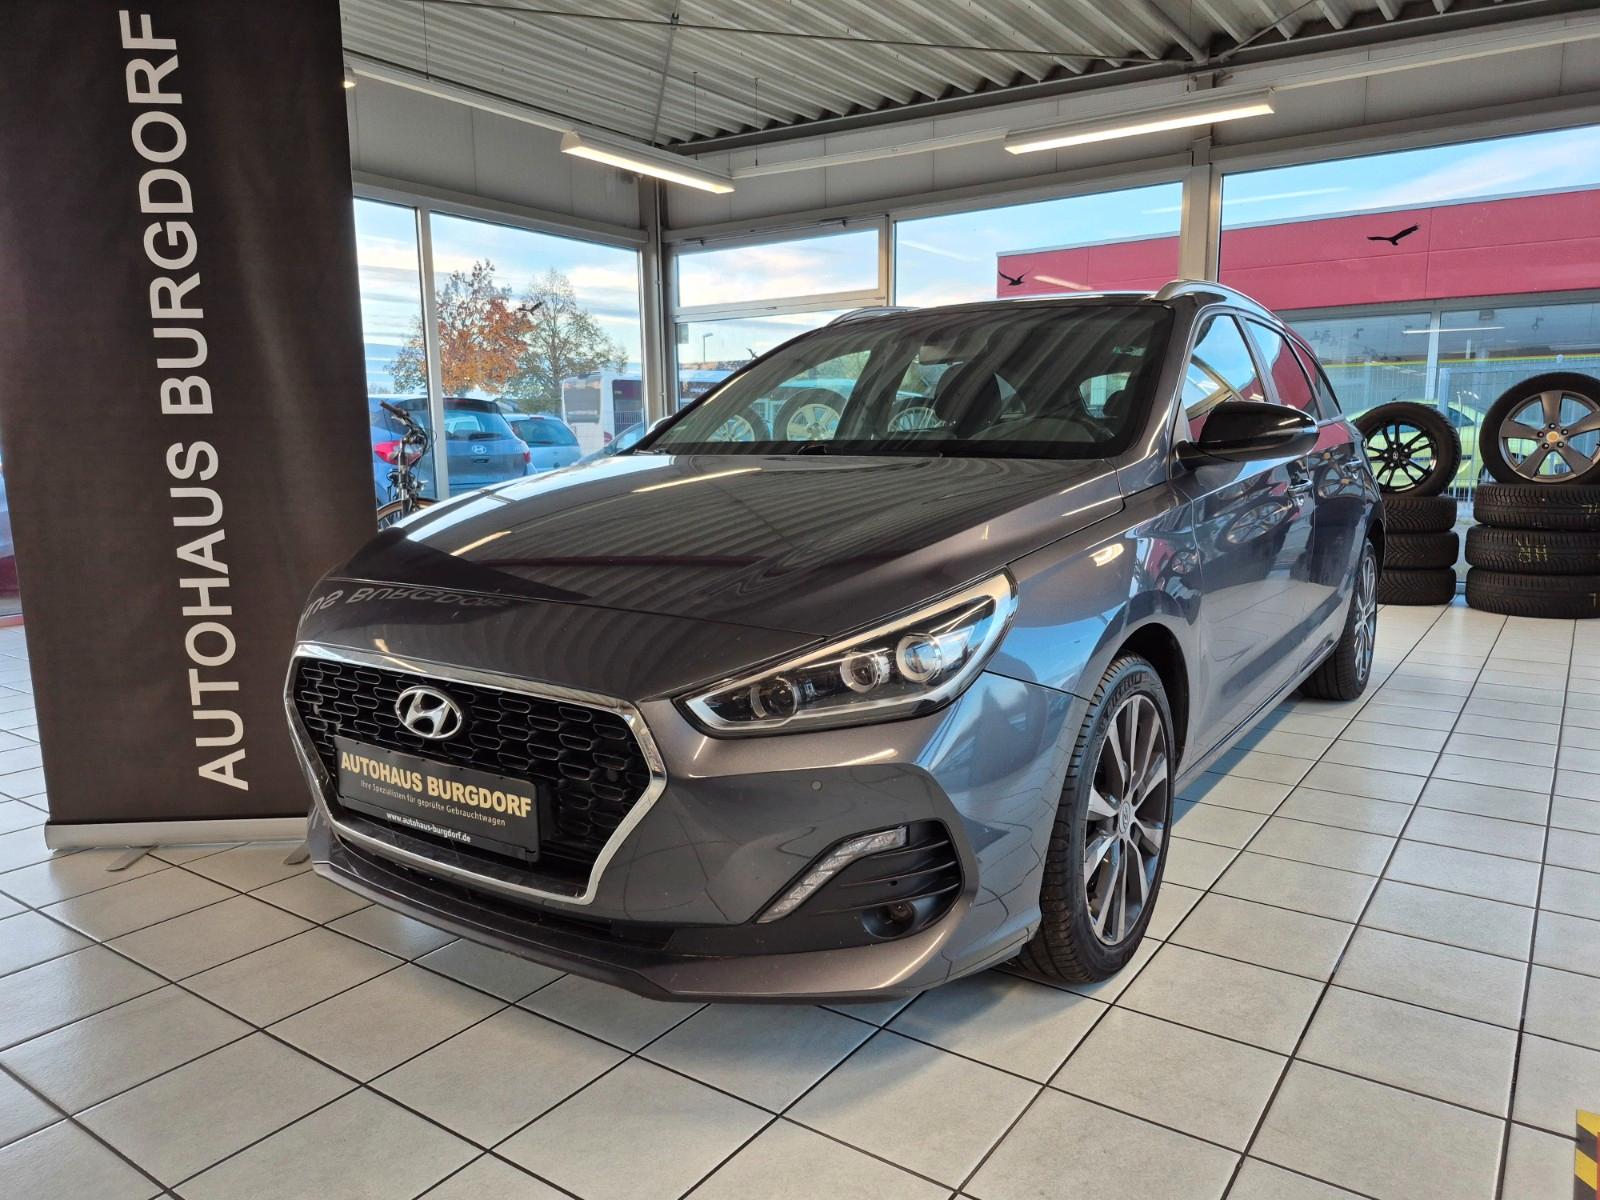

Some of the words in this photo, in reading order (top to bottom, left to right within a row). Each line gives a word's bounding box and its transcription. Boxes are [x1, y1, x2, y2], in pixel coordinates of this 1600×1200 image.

[119, 10, 213, 415] BURGDORF
[166, 441, 249, 791] AUTOHAUS
[341, 752, 422, 793] AUTOHAUS
[427, 776, 532, 817] BURGDORF
[446, 805, 506, 826] Gebrauchtwagen
[387, 812, 471, 843] www.autohaus-burgdorf.de
